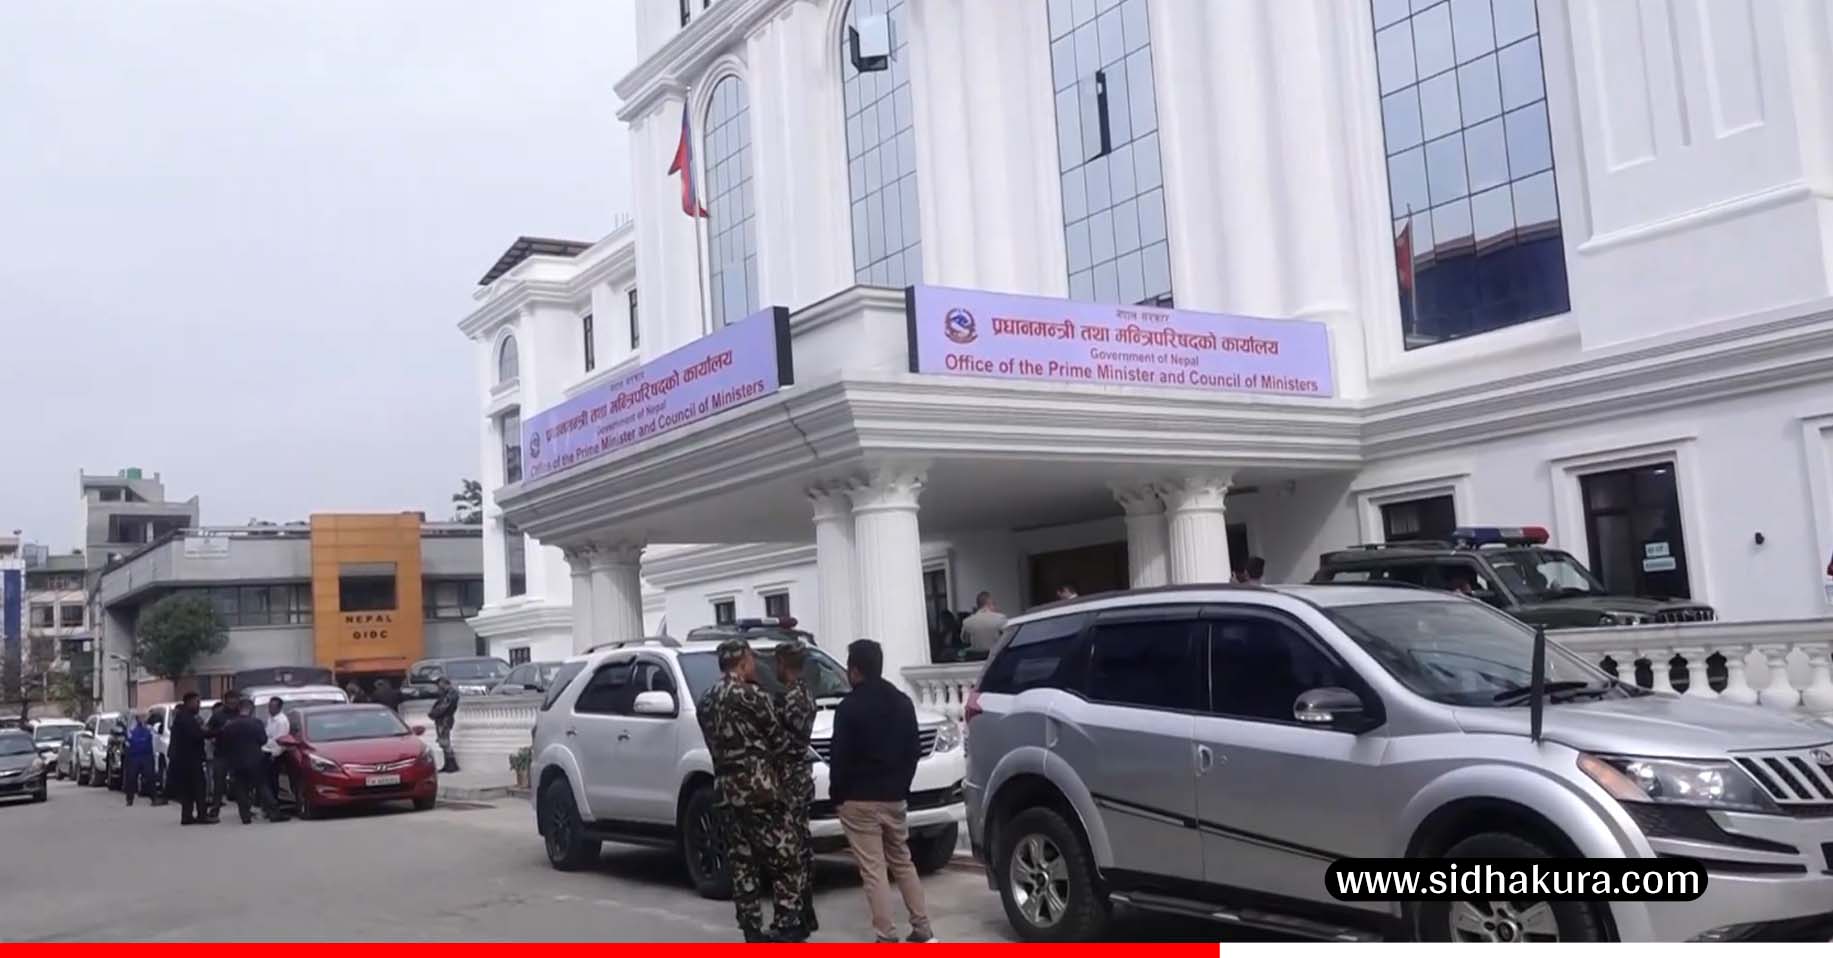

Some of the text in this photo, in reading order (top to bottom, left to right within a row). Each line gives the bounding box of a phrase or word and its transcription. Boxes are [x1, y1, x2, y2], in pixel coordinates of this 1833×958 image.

[1080, 325, 1109, 342] तथा
[1221, 335, 1279, 354] कार्यालय
[683, 350, 732, 383] कार्यालय
[1090, 347, 1199, 367] Government of Nepal
[945, 354, 1319, 392] Office of the Prime Minister and Council of Ministers
[658, 402, 696, 429] Council
[699, 396, 708, 413] of
[712, 380, 764, 409] Ministers
[345, 614, 392, 624] NEPAL
